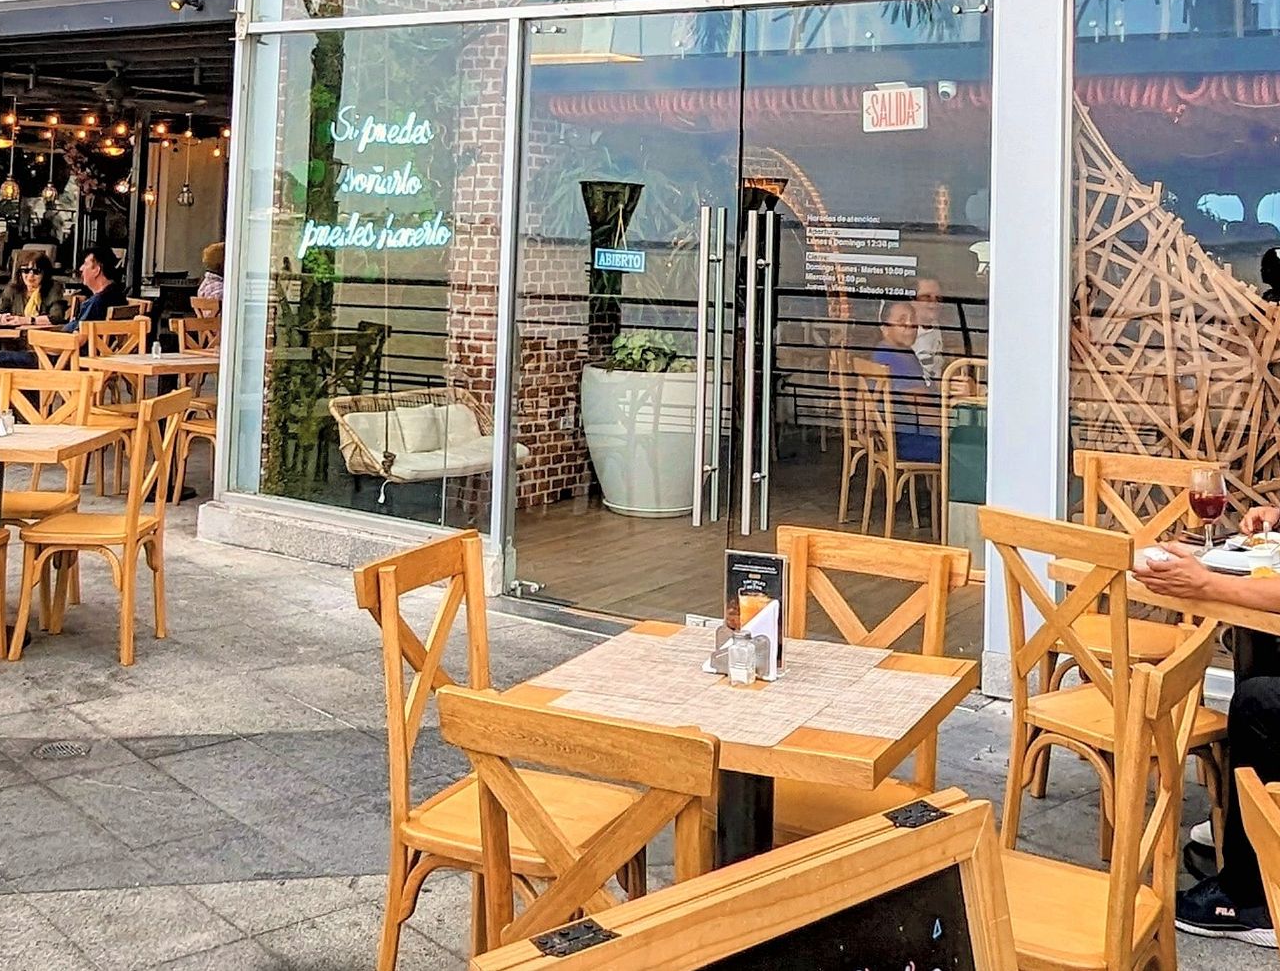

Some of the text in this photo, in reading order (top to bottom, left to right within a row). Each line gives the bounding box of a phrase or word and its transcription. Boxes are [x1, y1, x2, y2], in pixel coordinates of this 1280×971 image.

[870, 91, 916, 128] SALIDA
[598, 252, 641, 269] ABIERTO
[1215, 906, 1236, 917] FILA
